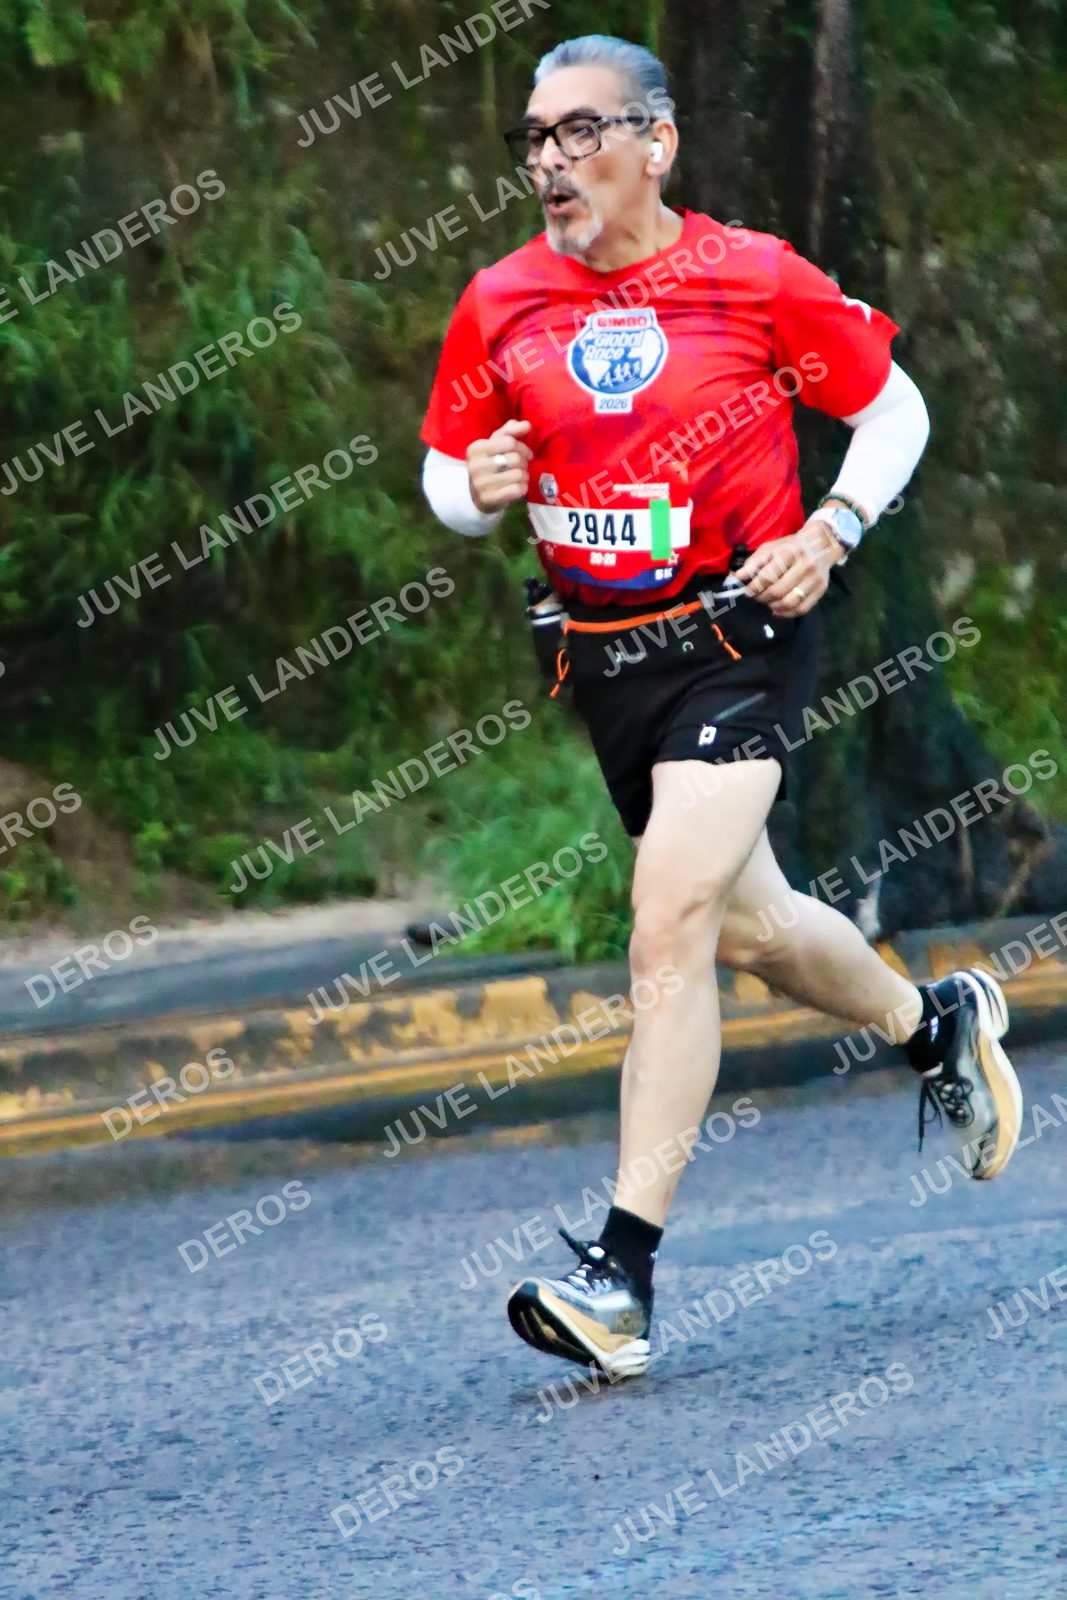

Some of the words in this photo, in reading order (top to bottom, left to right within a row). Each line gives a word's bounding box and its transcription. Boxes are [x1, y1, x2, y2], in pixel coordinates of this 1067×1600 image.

[597, 316, 647, 328] BIMBO
[595, 331, 642, 348] Global
[583, 345, 625, 360] Race
[599, 398, 629, 410] 2026
[568, 511, 637, 546] 2944
